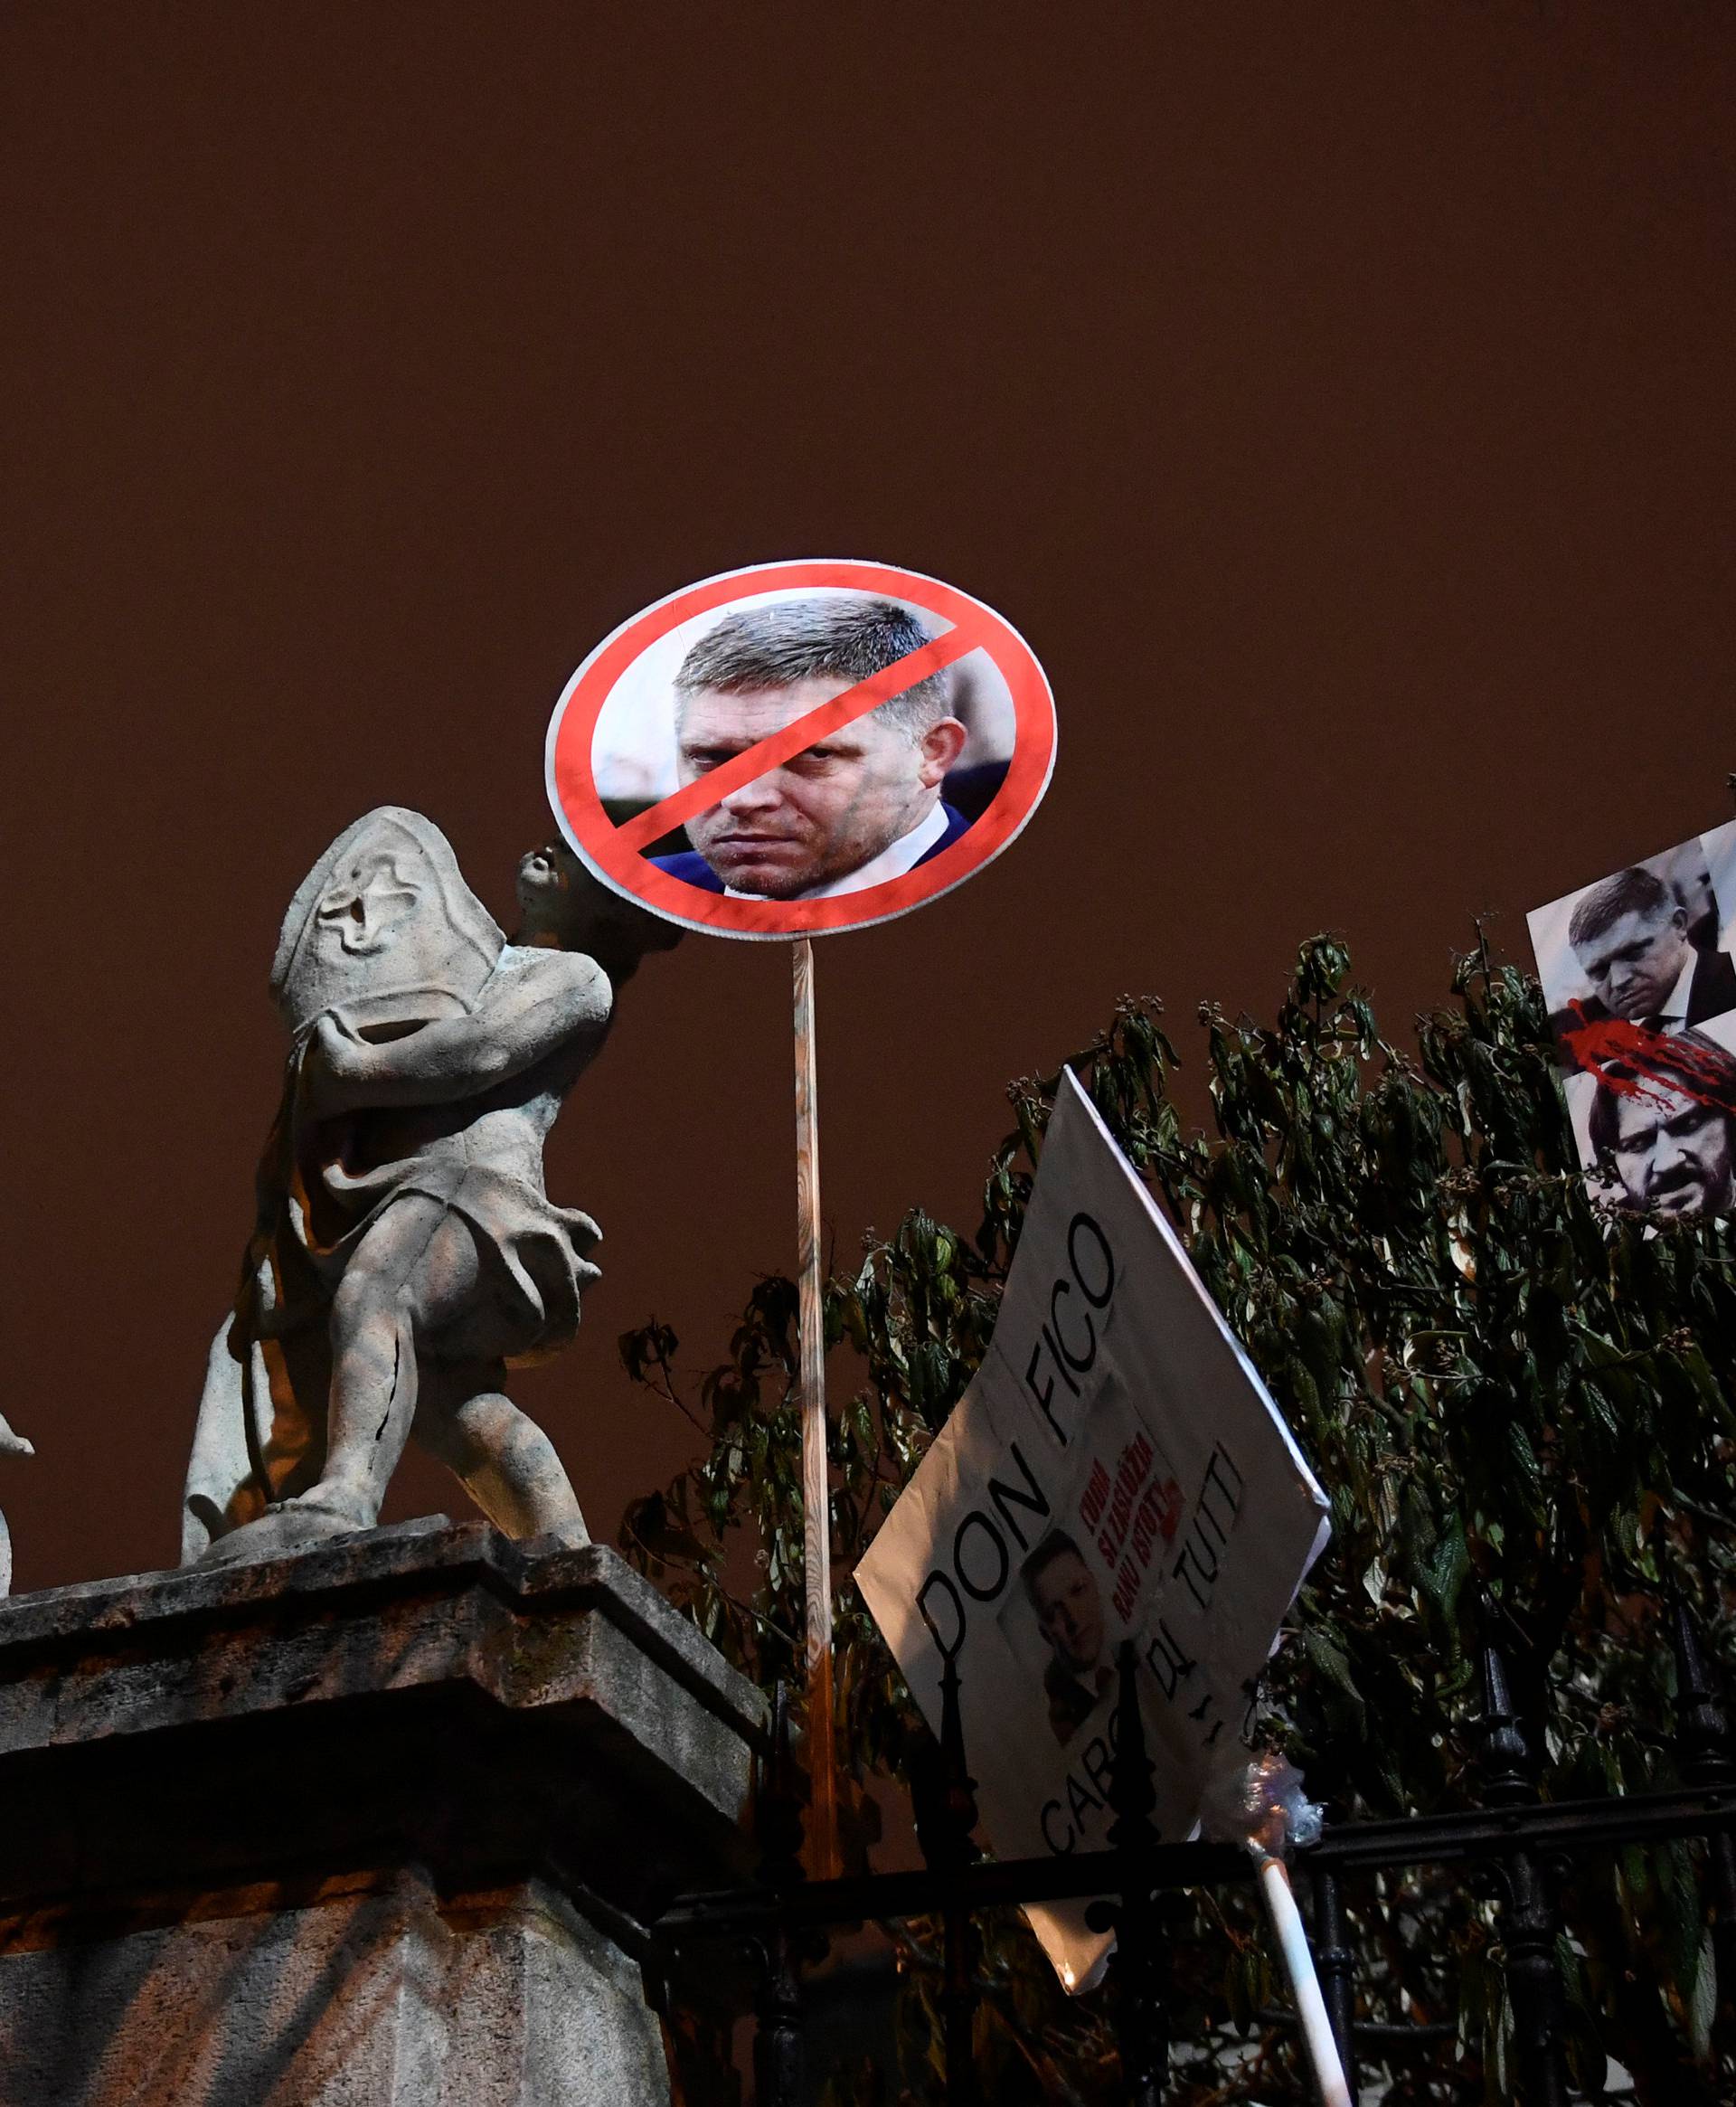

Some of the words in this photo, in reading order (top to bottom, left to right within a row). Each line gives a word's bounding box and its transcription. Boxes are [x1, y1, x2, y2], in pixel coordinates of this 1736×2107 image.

[916, 1441, 1051, 1660] DON
[1025, 1211, 1115, 1447] FICO
[1098, 1528, 1118, 1569] SI
[1146, 1618, 1192, 1701] DI
[1172, 1440, 1243, 1609] TUTTI
